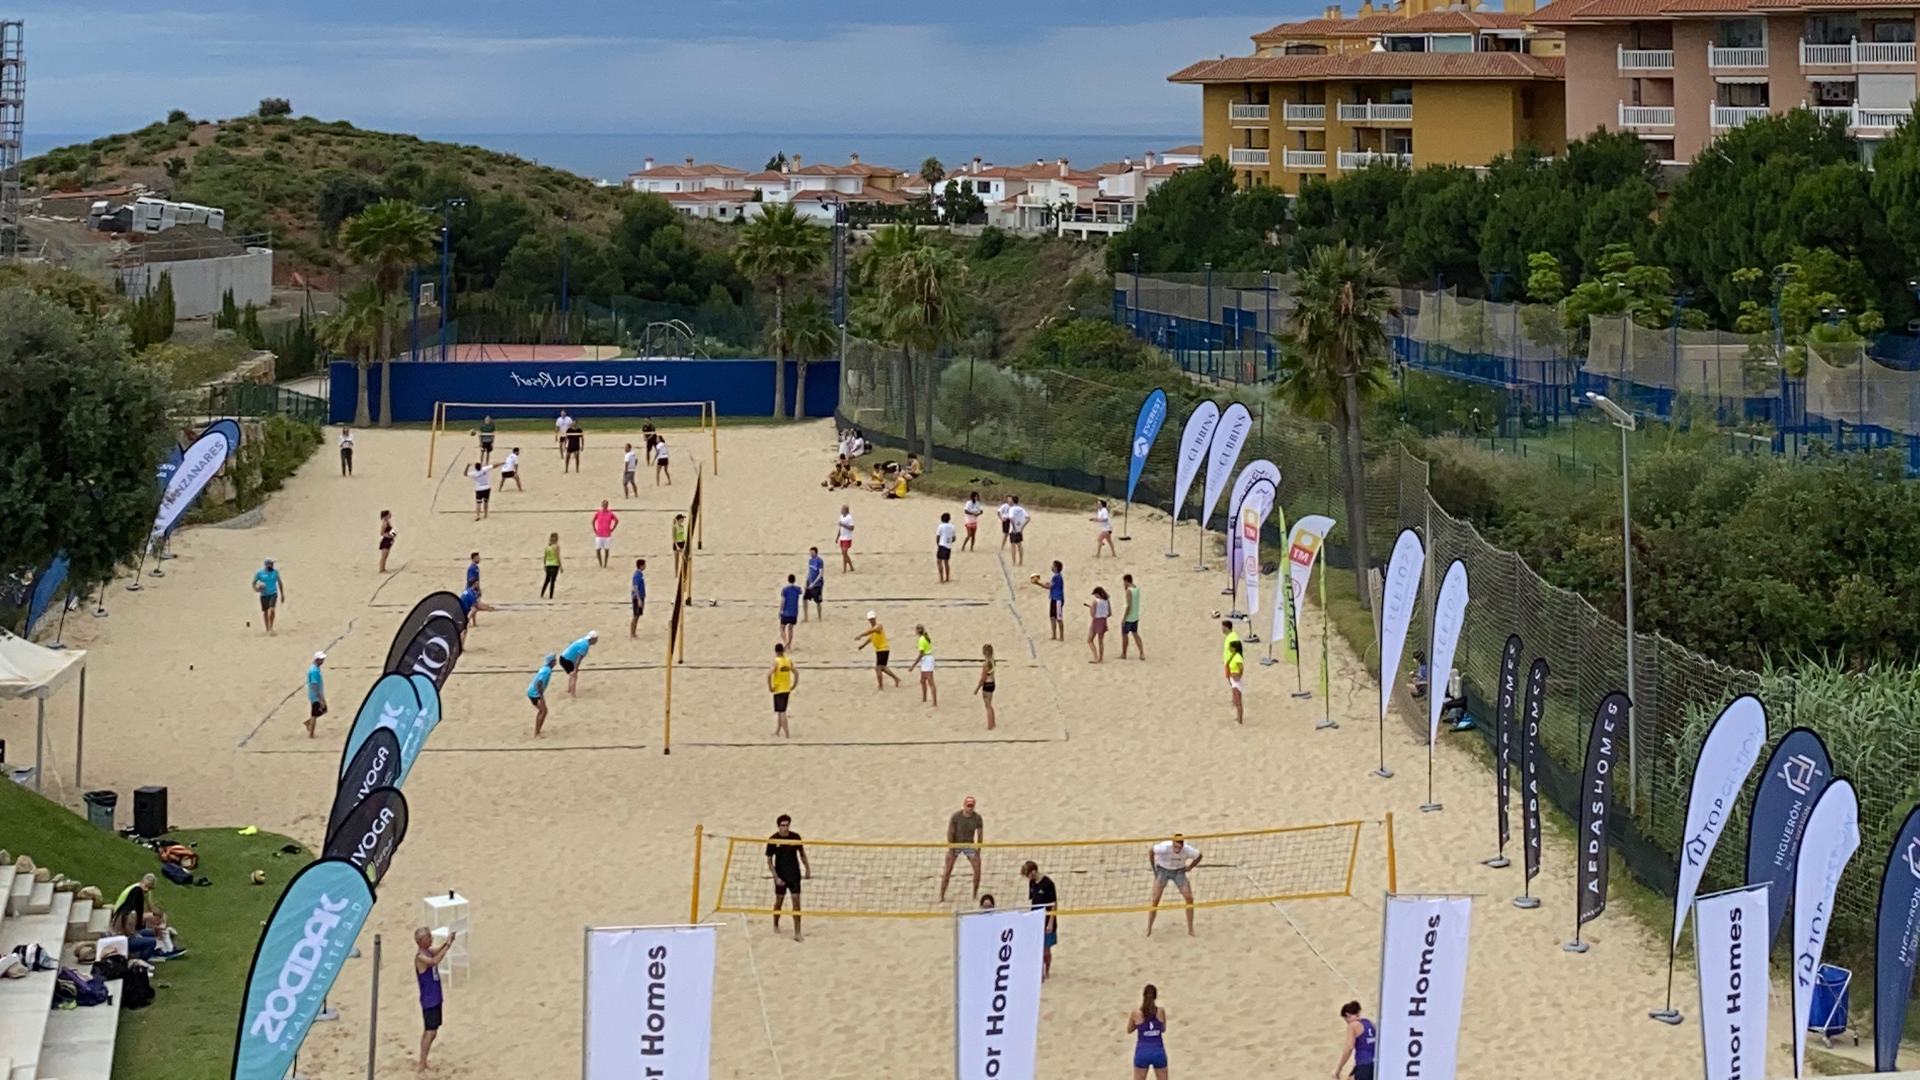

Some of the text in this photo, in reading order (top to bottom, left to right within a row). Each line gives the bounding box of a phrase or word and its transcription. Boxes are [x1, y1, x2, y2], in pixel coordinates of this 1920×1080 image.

[1142, 397, 1162, 436] EVEREST
[1219, 415, 1246, 466] GUBBINS
[162, 441, 225, 510] MANZANARES
[1292, 547, 1310, 563] TM
[1703, 799, 1723, 835] TOP
[985, 928, 1014, 1036] Homes
[1408, 914, 1441, 1017] Homes
[1726, 907, 1743, 1015] Homes
[640, 945, 667, 1056] Homes
